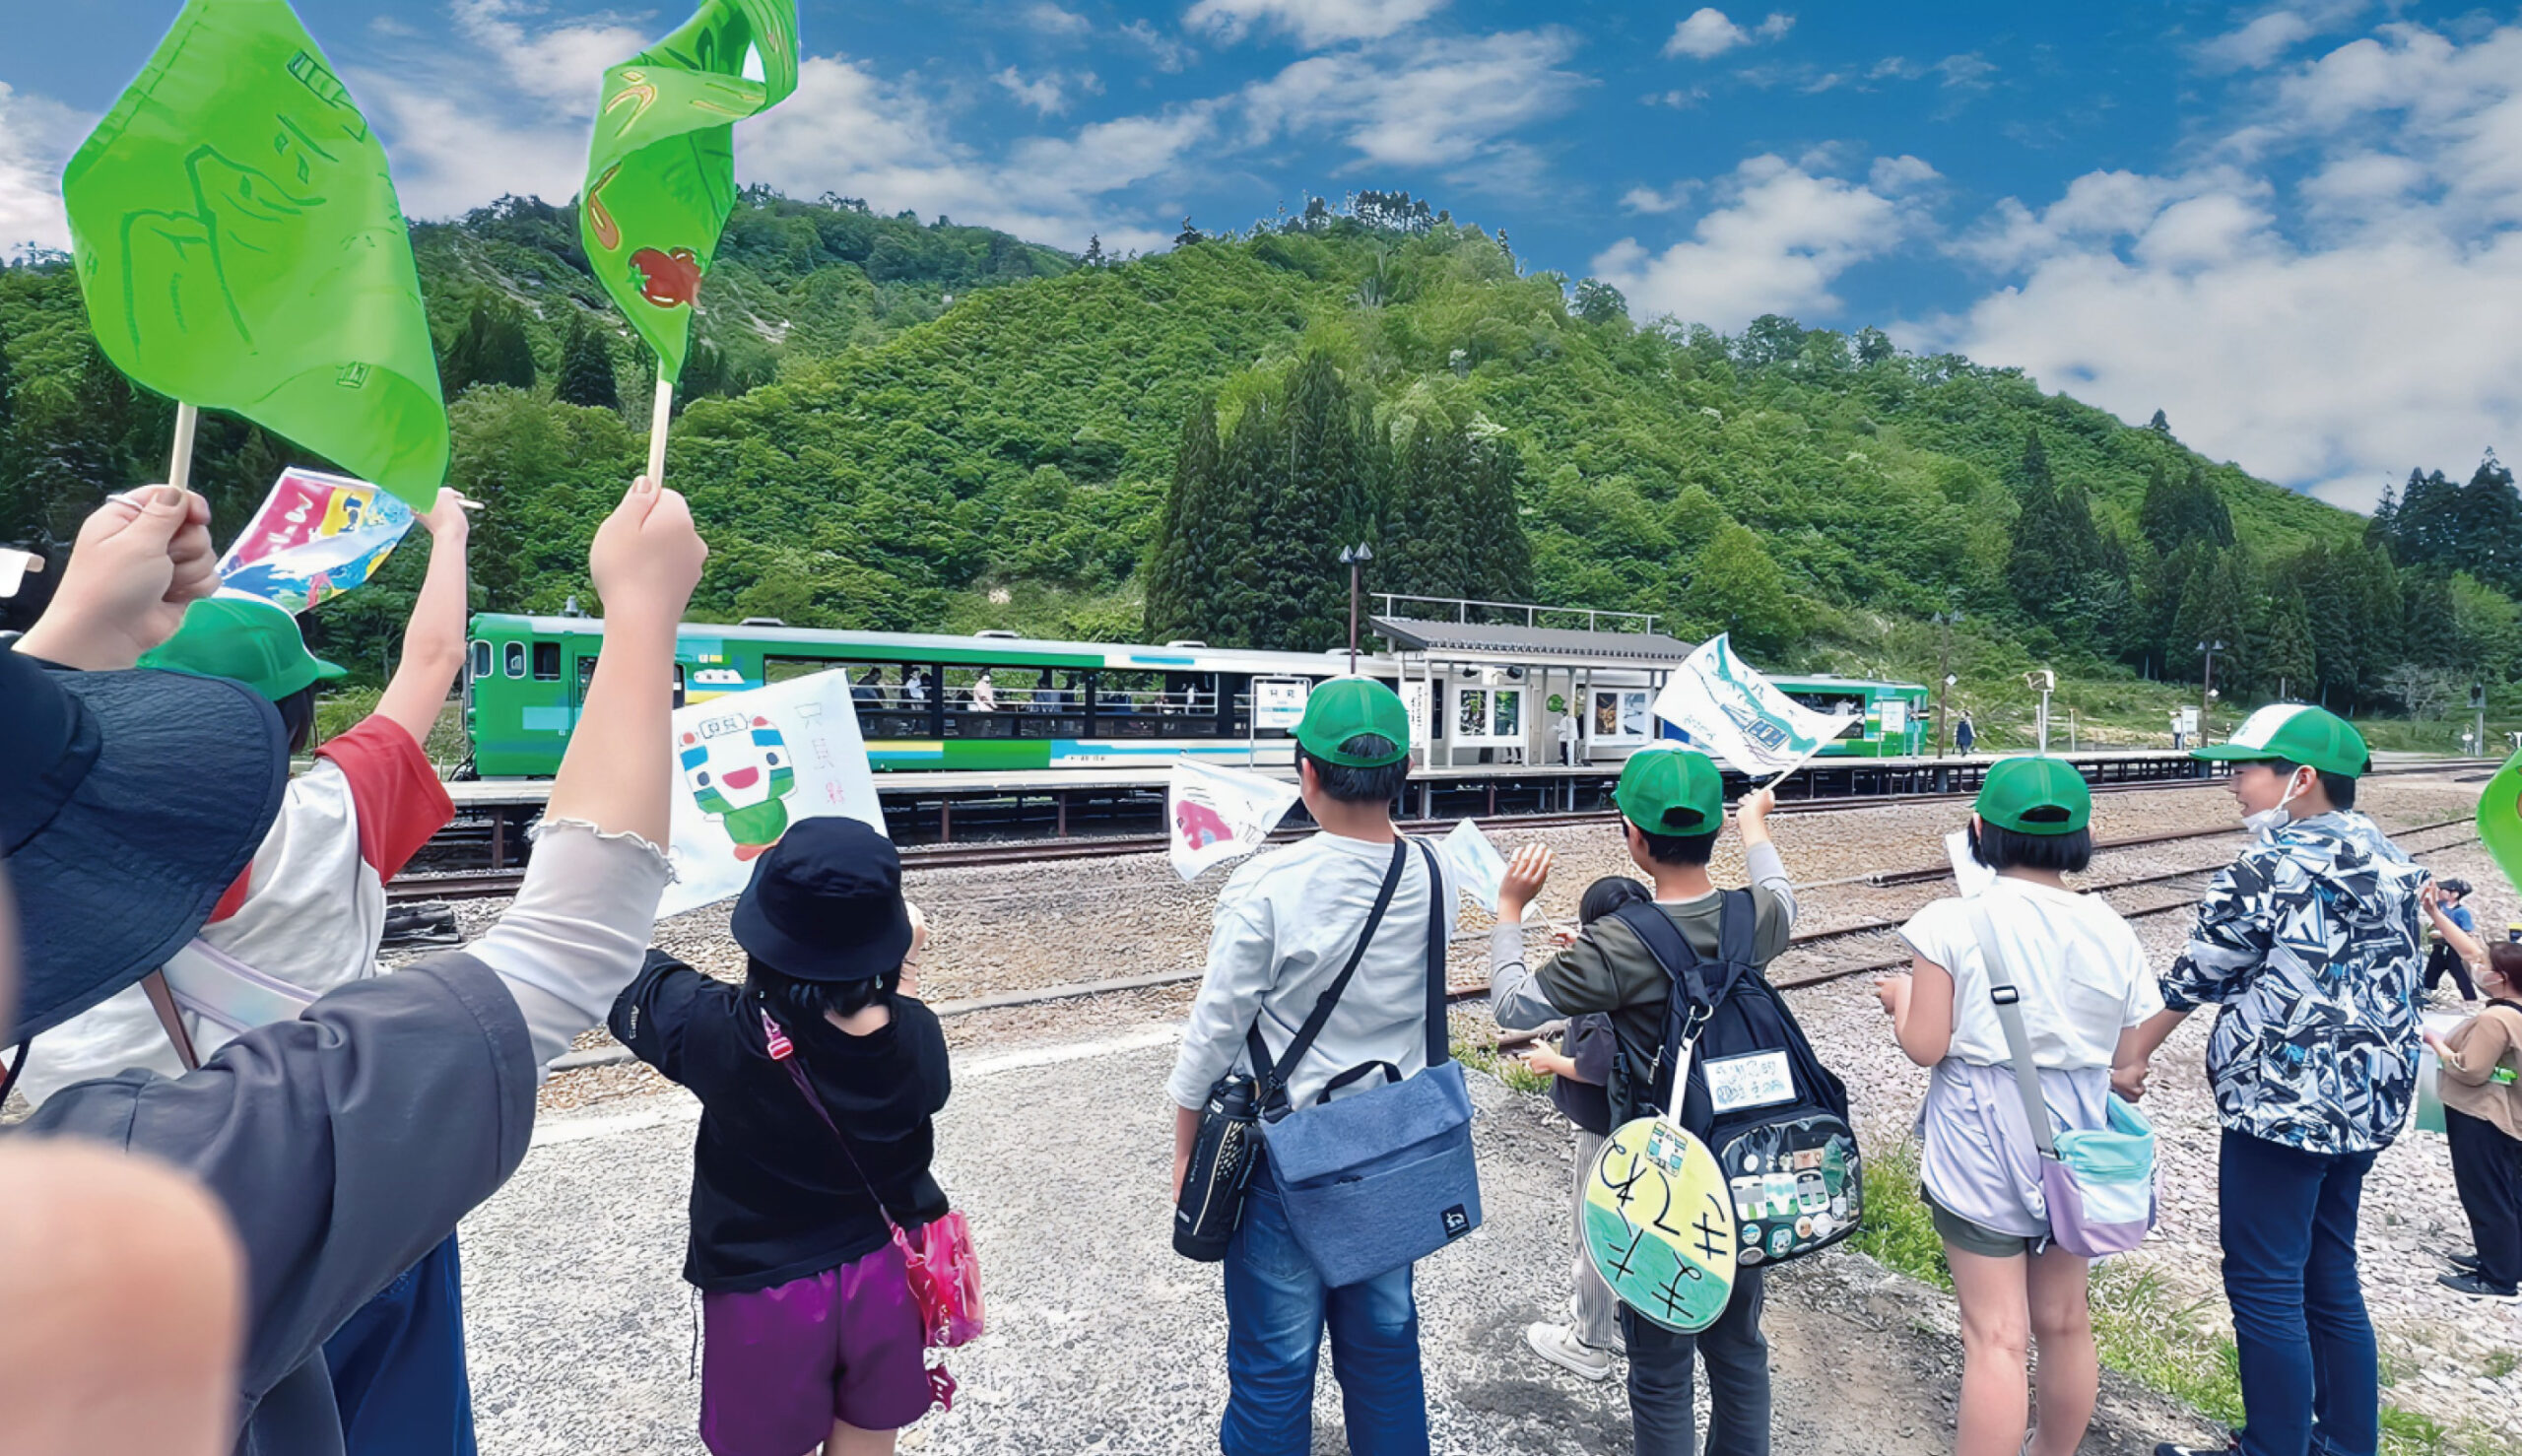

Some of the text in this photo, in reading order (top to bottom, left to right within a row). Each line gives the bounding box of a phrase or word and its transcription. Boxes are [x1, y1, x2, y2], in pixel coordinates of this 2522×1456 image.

[1599, 1137, 1728, 1261] きてね
[1607, 1206, 1702, 1320] また
